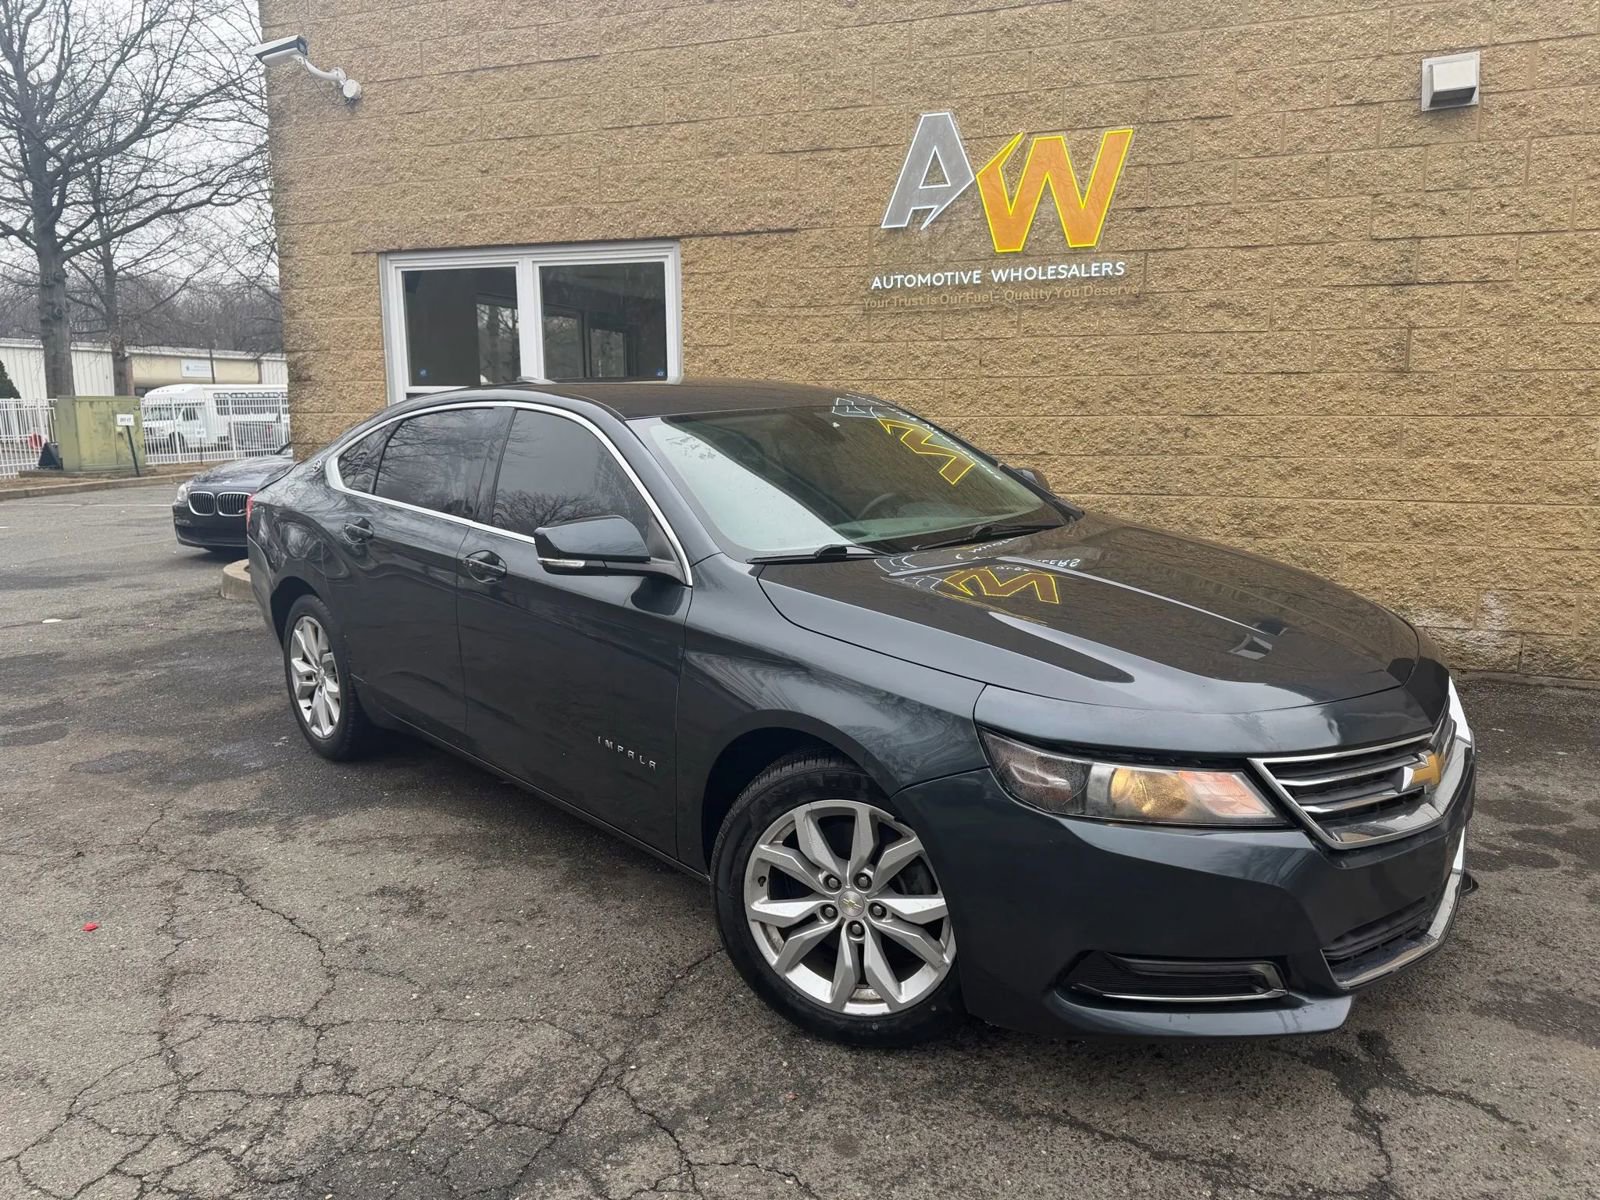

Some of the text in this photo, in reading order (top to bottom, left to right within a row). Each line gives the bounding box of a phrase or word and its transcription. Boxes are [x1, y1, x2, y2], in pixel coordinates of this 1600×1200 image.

[880, 111, 1134, 253] AW
[870, 261, 1126, 290] AUTOMOTIVE WHOLESALERS
[863, 297, 890, 310] Your
[892, 294, 924, 307] Trust
[926, 293, 937, 305] is
[940, 292, 963, 305] Our
[966, 291, 994, 304] Fuel
[1004, 287, 1051, 304] Quality
[1054, 285, 1080, 299] You
[1082, 283, 1140, 298] Deserve
[597, 735, 657, 771] IMPALA
